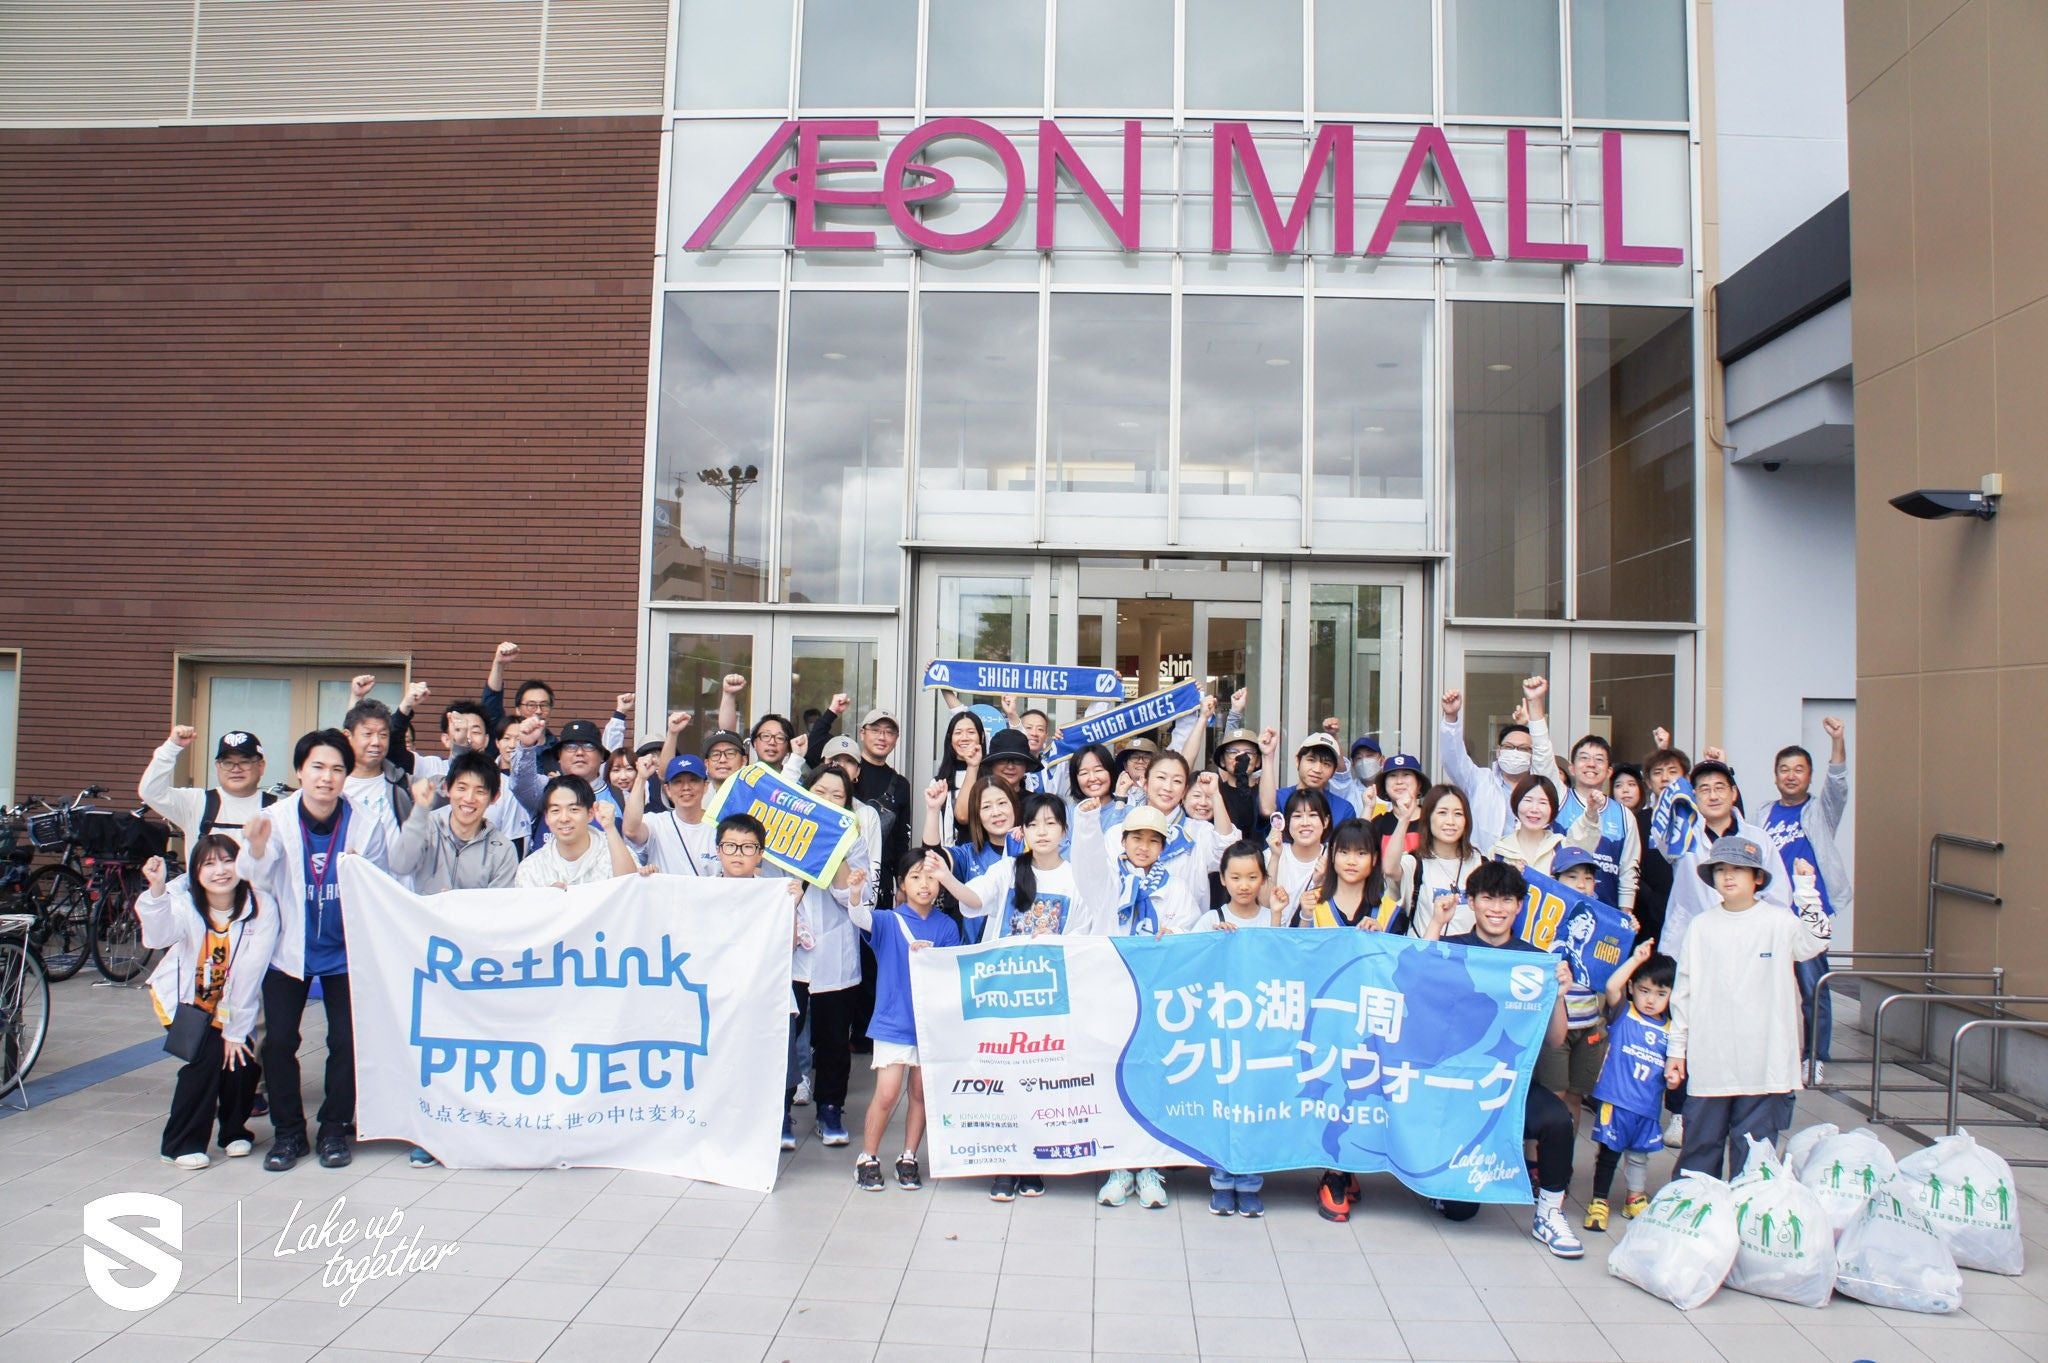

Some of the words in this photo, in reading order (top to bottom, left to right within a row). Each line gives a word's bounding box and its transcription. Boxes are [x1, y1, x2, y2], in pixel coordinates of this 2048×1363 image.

[1212, 122, 1683, 266] MALL
[978, 666, 1020, 689] SHIGA
[1024, 668, 1068, 692] LAKES
[1081, 712, 1127, 742] SHIGA
[1130, 694, 1176, 731] LAKES
[1520, 884, 1567, 953] 18
[426, 931, 693, 990] Rethink
[974, 955, 1052, 979] Rethink
[974, 989, 1056, 1009] PROJECT
[1153, 979, 1407, 1044] びわ湖一周
[418, 1038, 705, 1096] PROJECT
[1039, 1073, 1095, 1091] hummel
[1160, 1039, 1519, 1112] クリーンウォーク
[1632, 1061, 1651, 1082] 17
[1067, 1103, 1102, 1118] MALL
[1166, 1100, 1205, 1117] with
[1212, 1100, 1292, 1123] Rethink
[1300, 1098, 1390, 1129] PROJECT
[950, 1142, 1018, 1157] Logisnext
[1449, 1144, 1485, 1169] Lake
[1484, 1152, 1497, 1172] up
[1467, 1160, 1520, 1193] together
